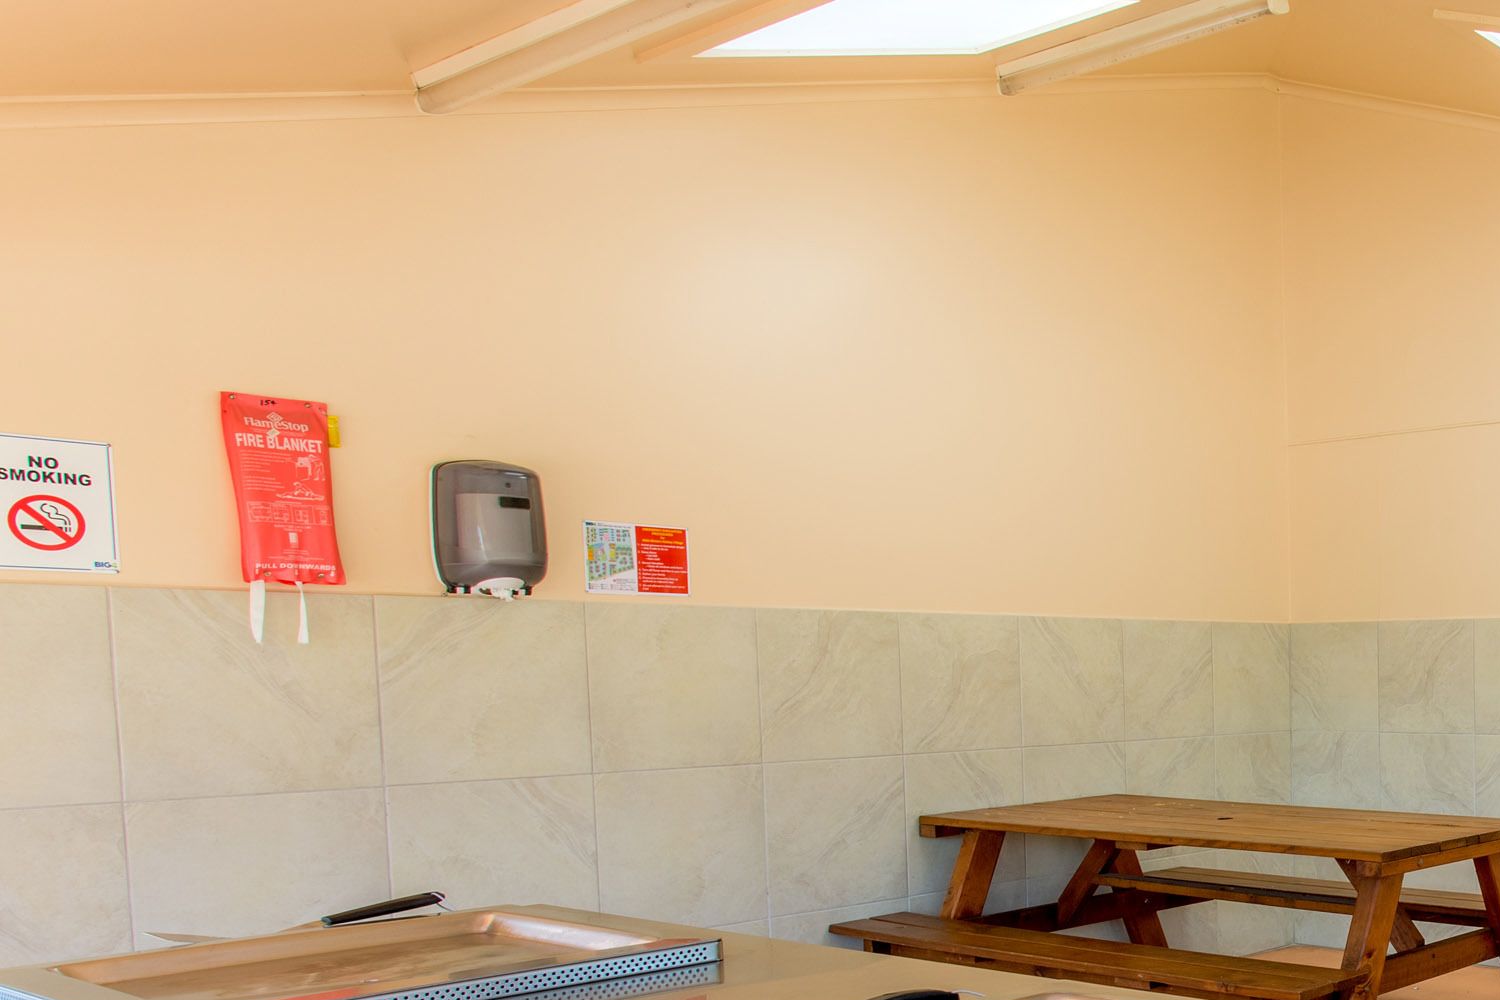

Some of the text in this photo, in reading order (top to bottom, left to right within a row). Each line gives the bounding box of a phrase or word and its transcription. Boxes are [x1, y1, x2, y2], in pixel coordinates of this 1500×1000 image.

[243, 415, 309, 433] FlameStop
[234, 432, 323, 453] FIRE BLANKET
[27, 455, 60, 470] NO
[0, 467, 92, 486] SMOKING
